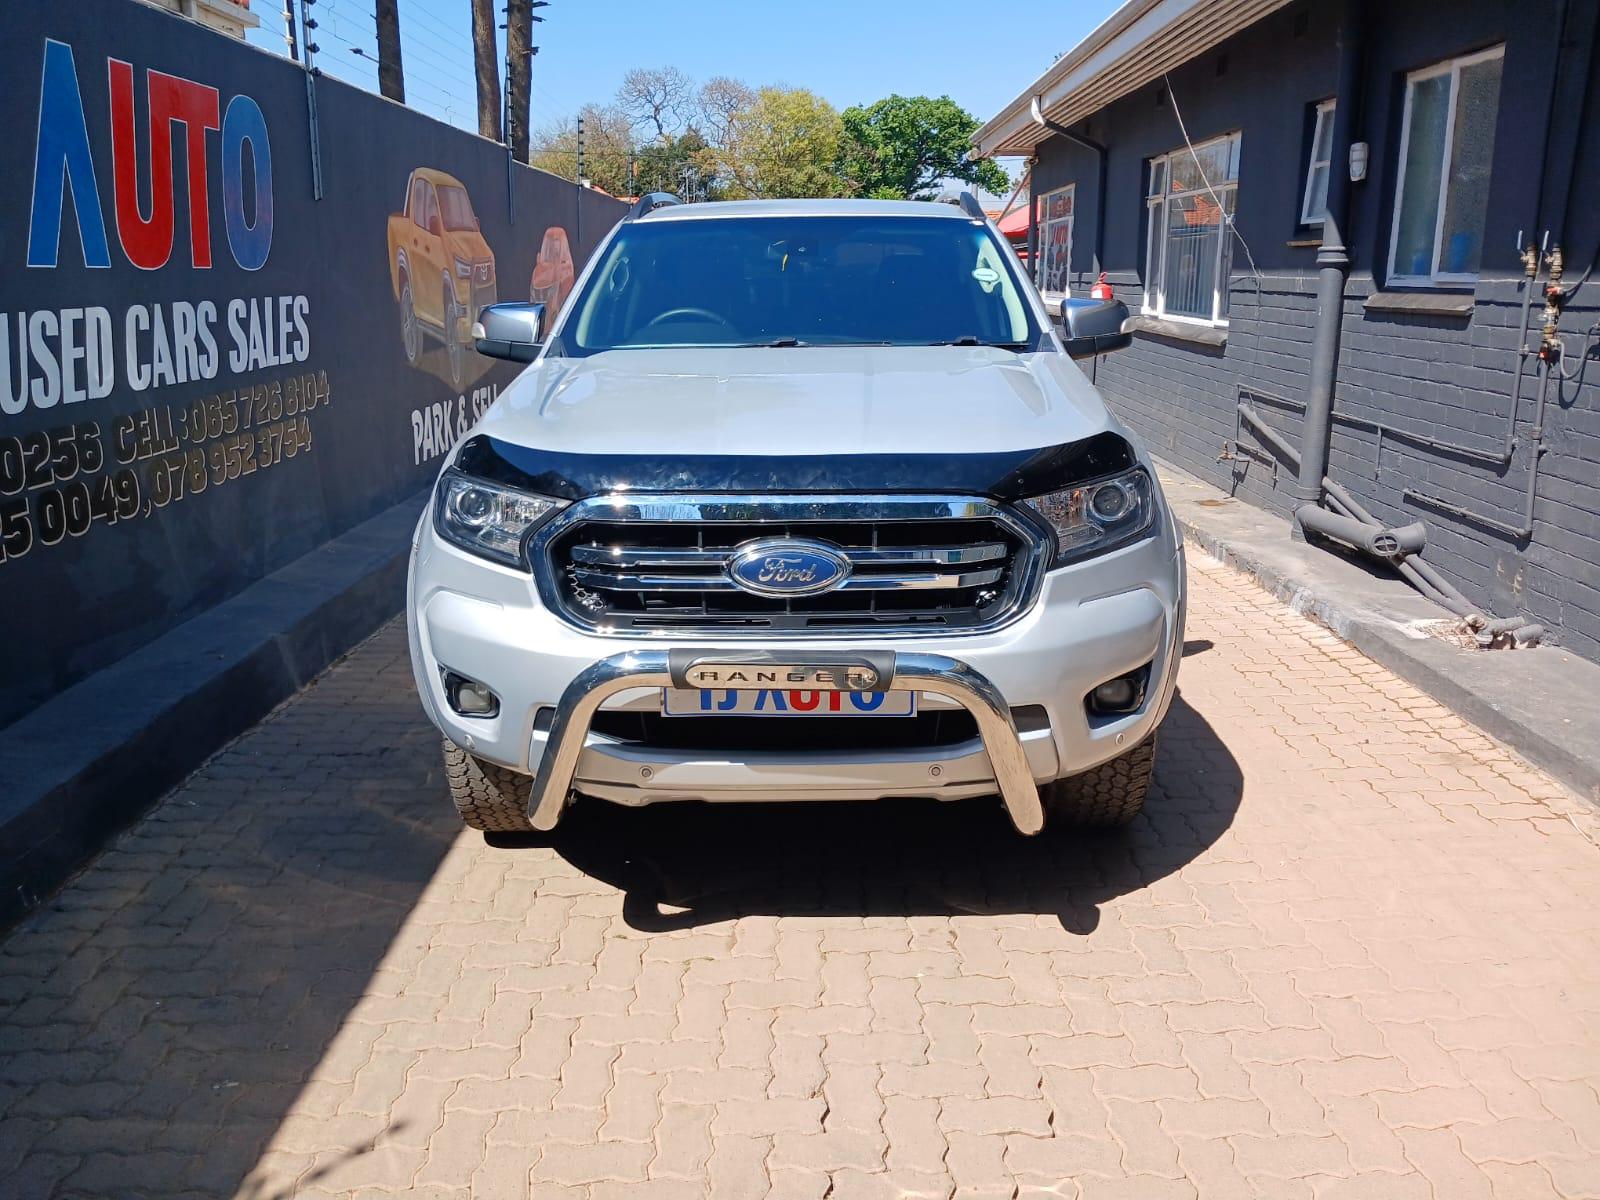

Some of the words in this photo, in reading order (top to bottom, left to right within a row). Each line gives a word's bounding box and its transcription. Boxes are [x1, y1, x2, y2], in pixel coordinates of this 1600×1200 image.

[26, 37, 274, 271] AUTO
[0, 306, 114, 415] USED
[126, 300, 219, 391] CARS
[228, 295, 310, 373] SALES
[0, 421, 104, 496] 0256
[257, 415, 312, 468] 3754
[411, 401, 456, 466] PARK
[456, 394, 468, 439] &
[758, 557, 816, 583] Ford
[700, 671, 869, 683] RANGER
